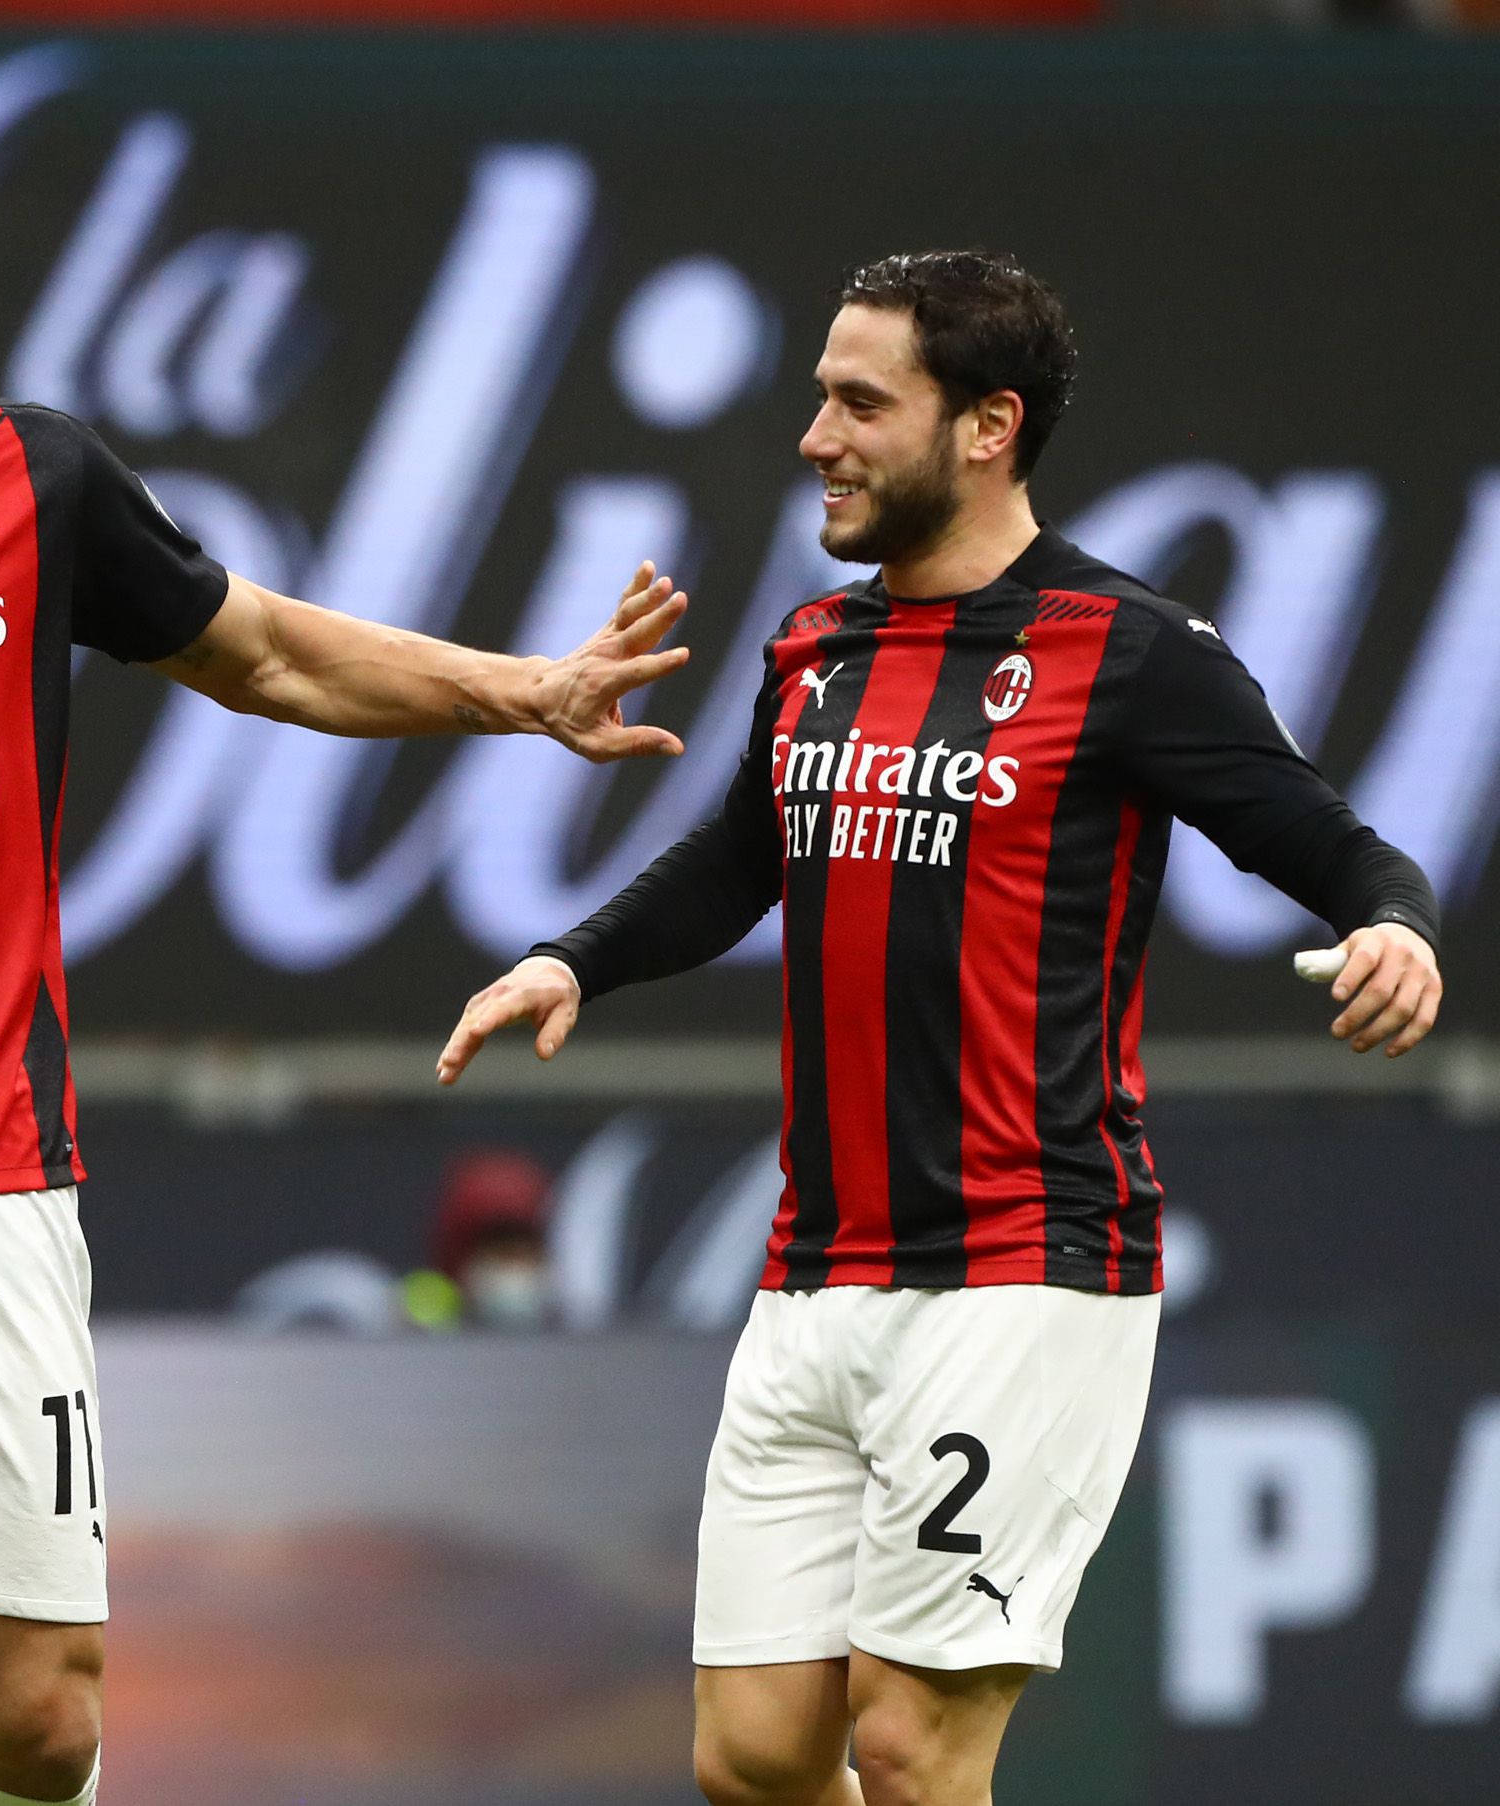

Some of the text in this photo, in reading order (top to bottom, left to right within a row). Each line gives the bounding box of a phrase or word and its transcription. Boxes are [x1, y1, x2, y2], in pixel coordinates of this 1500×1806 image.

[771, 727, 1021, 808] Emirates
[783, 803, 959, 867] FLY BETTER
[41, 1389, 98, 1516] 11
[916, 1431, 992, 1555] 2
